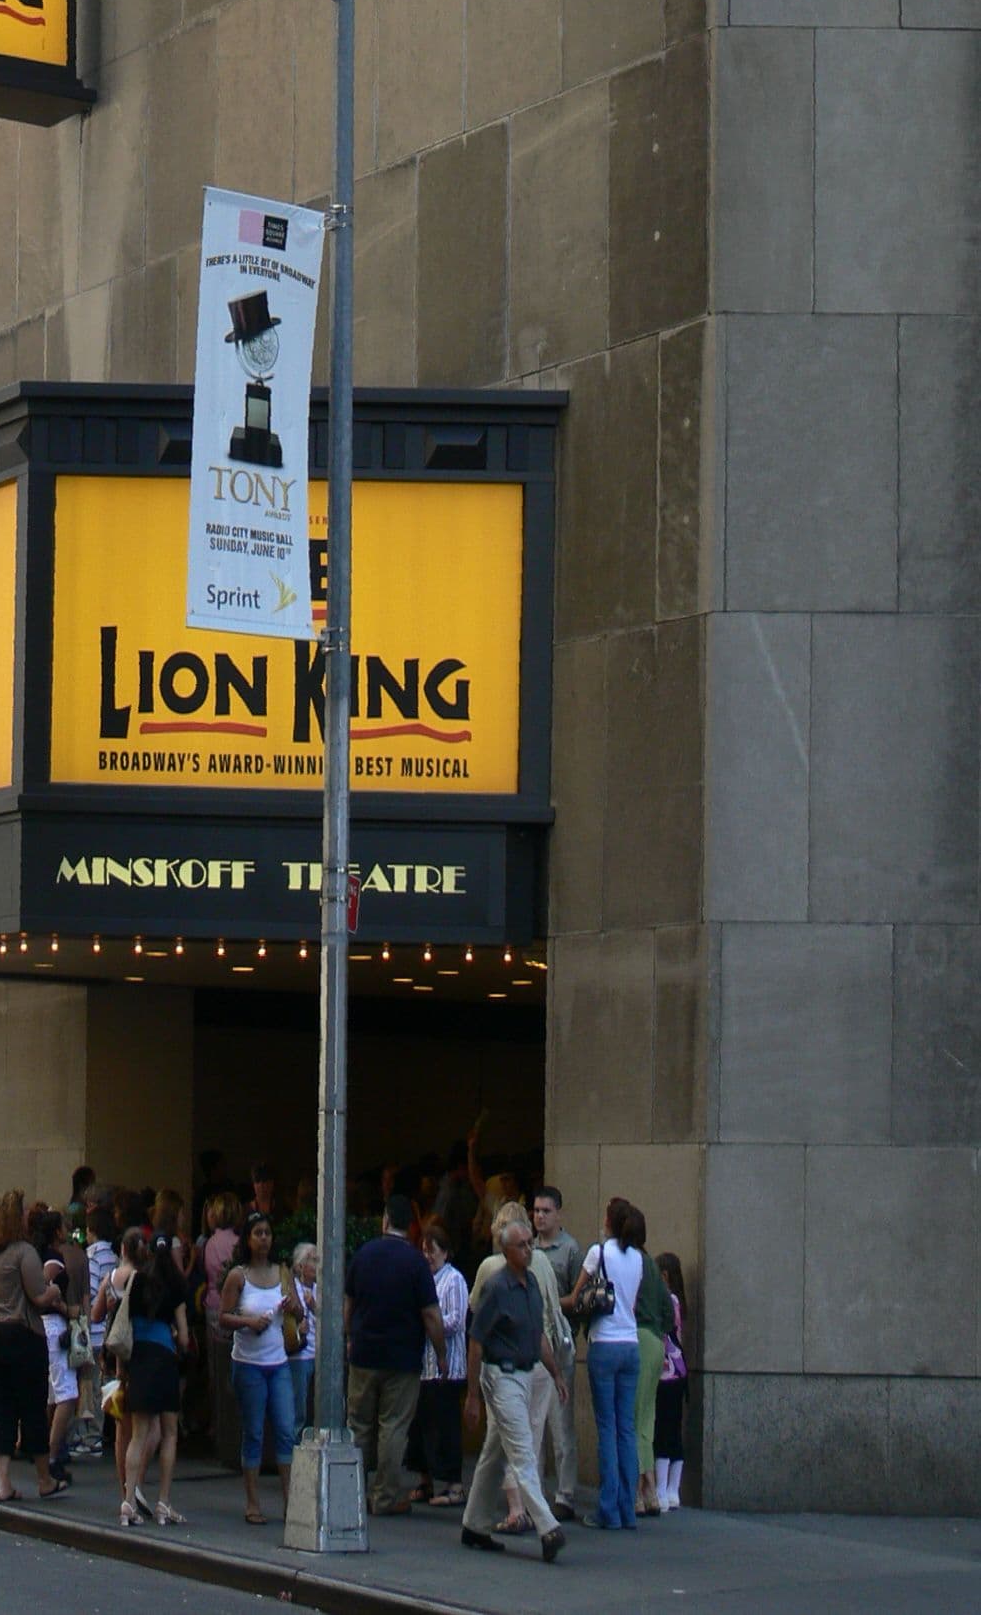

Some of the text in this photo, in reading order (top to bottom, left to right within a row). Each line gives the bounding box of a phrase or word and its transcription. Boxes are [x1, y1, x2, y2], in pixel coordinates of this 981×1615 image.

[206, 254, 315, 289] THERE'S A LITTLE BIT OF BROADWAY
[240, 265, 280, 282] IN EVERYONE
[208, 465, 297, 512] TONY
[206, 523, 294, 546] RADIO CITY MUSIC HALL
[209, 537, 249, 556] SUNDAY,
[251, 542, 276, 558] JUNE
[206, 583, 261, 610] Sprint
[99, 626, 471, 743] LION KING
[98, 751, 470, 779] BROADWAY'S AWARD-WINNI BEST MUSICAL
[55, 856, 256, 890] MINSKOFF
